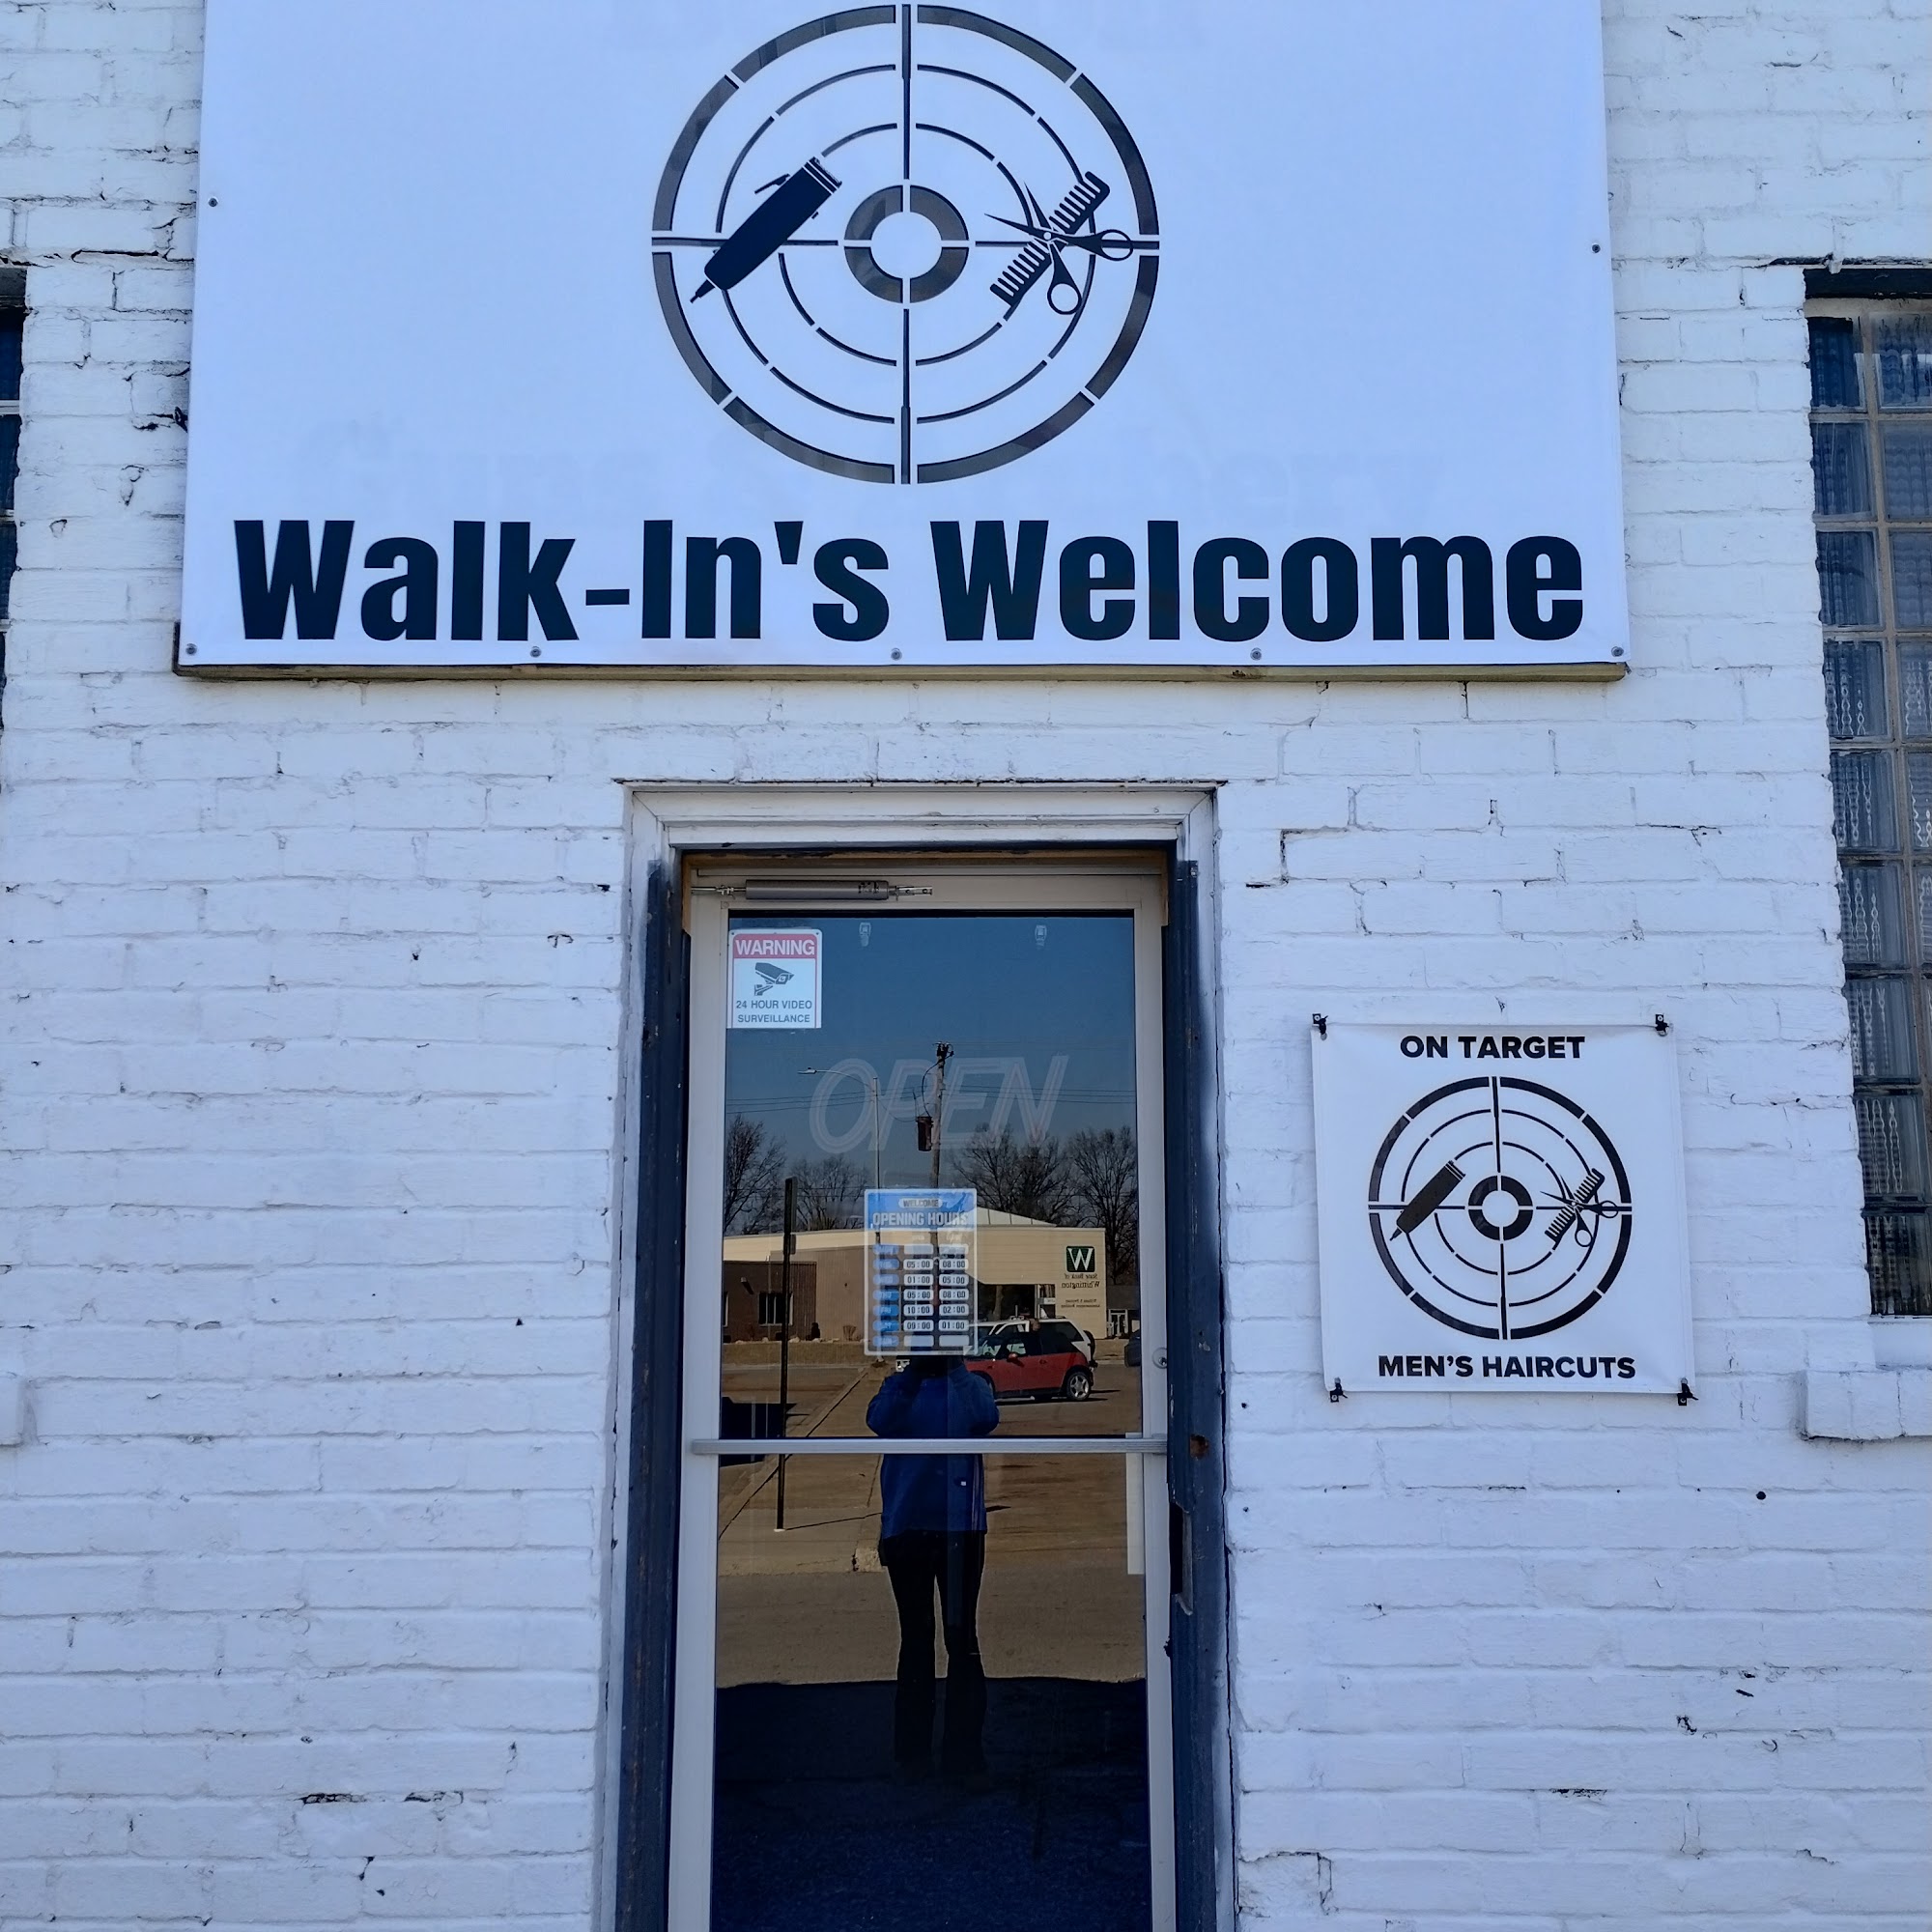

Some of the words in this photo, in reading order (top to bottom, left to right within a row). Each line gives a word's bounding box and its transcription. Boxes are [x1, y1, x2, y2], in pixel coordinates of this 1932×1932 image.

[234, 520, 890, 641] Walk-In's
[929, 520, 1583, 641] Welcome
[735, 939, 815, 955] WARNING
[736, 1000, 748, 1009] 24
[751, 1000, 779, 1009] HOUR
[781, 1000, 812, 1009] VIDEO
[737, 1014, 810, 1023] SURVEILLANCE
[1400, 1036, 1447, 1058] ON
[1458, 1036, 1585, 1059] TARGET
[809, 1055, 1069, 1154] OPEN
[903, 1199, 939, 1208] WELCOME
[872, 1212, 924, 1226] OPENING
[927, 1212, 969, 1226] HOURS
[1378, 1355, 1473, 1378] MEN'S
[1483, 1355, 1635, 1378] HAIRCUTS
